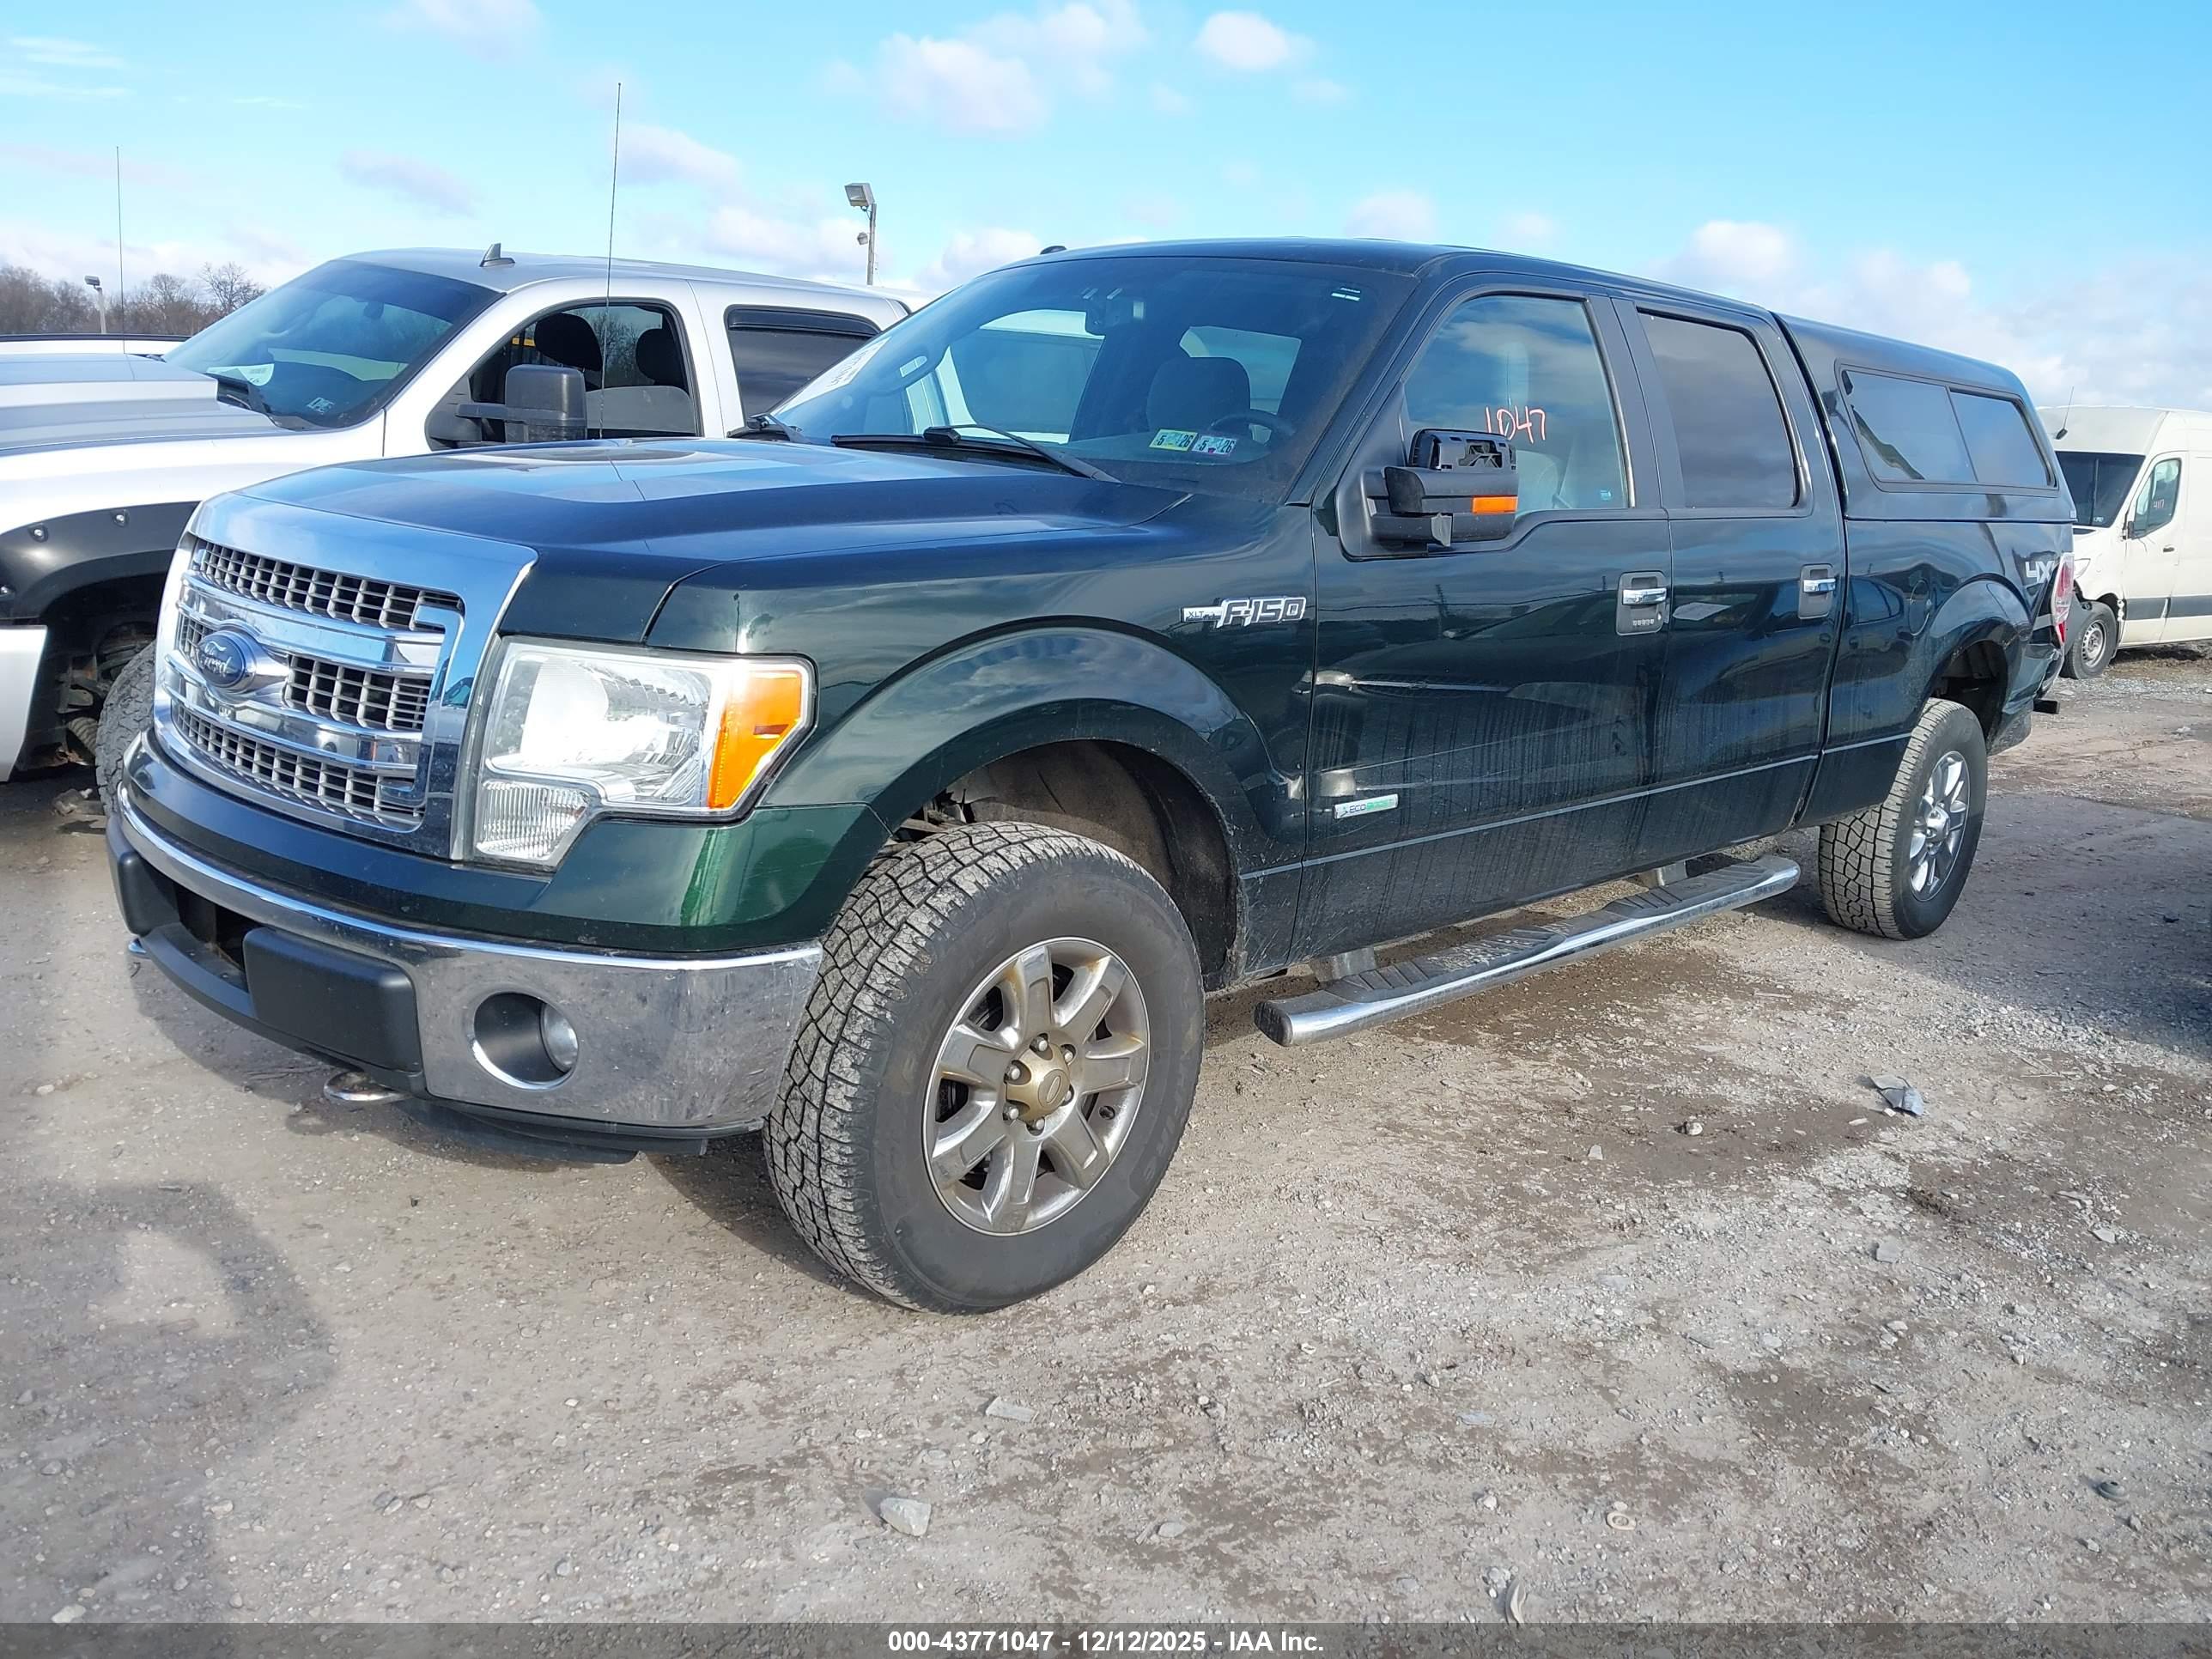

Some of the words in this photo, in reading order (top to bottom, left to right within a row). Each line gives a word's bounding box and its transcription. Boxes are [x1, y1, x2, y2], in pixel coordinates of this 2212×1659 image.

[1485, 404, 1547, 444] 1047
[1188, 611, 1204, 619] XLT
[1217, 598, 1306, 628] F-150
[198, 641, 236, 677] Ford
